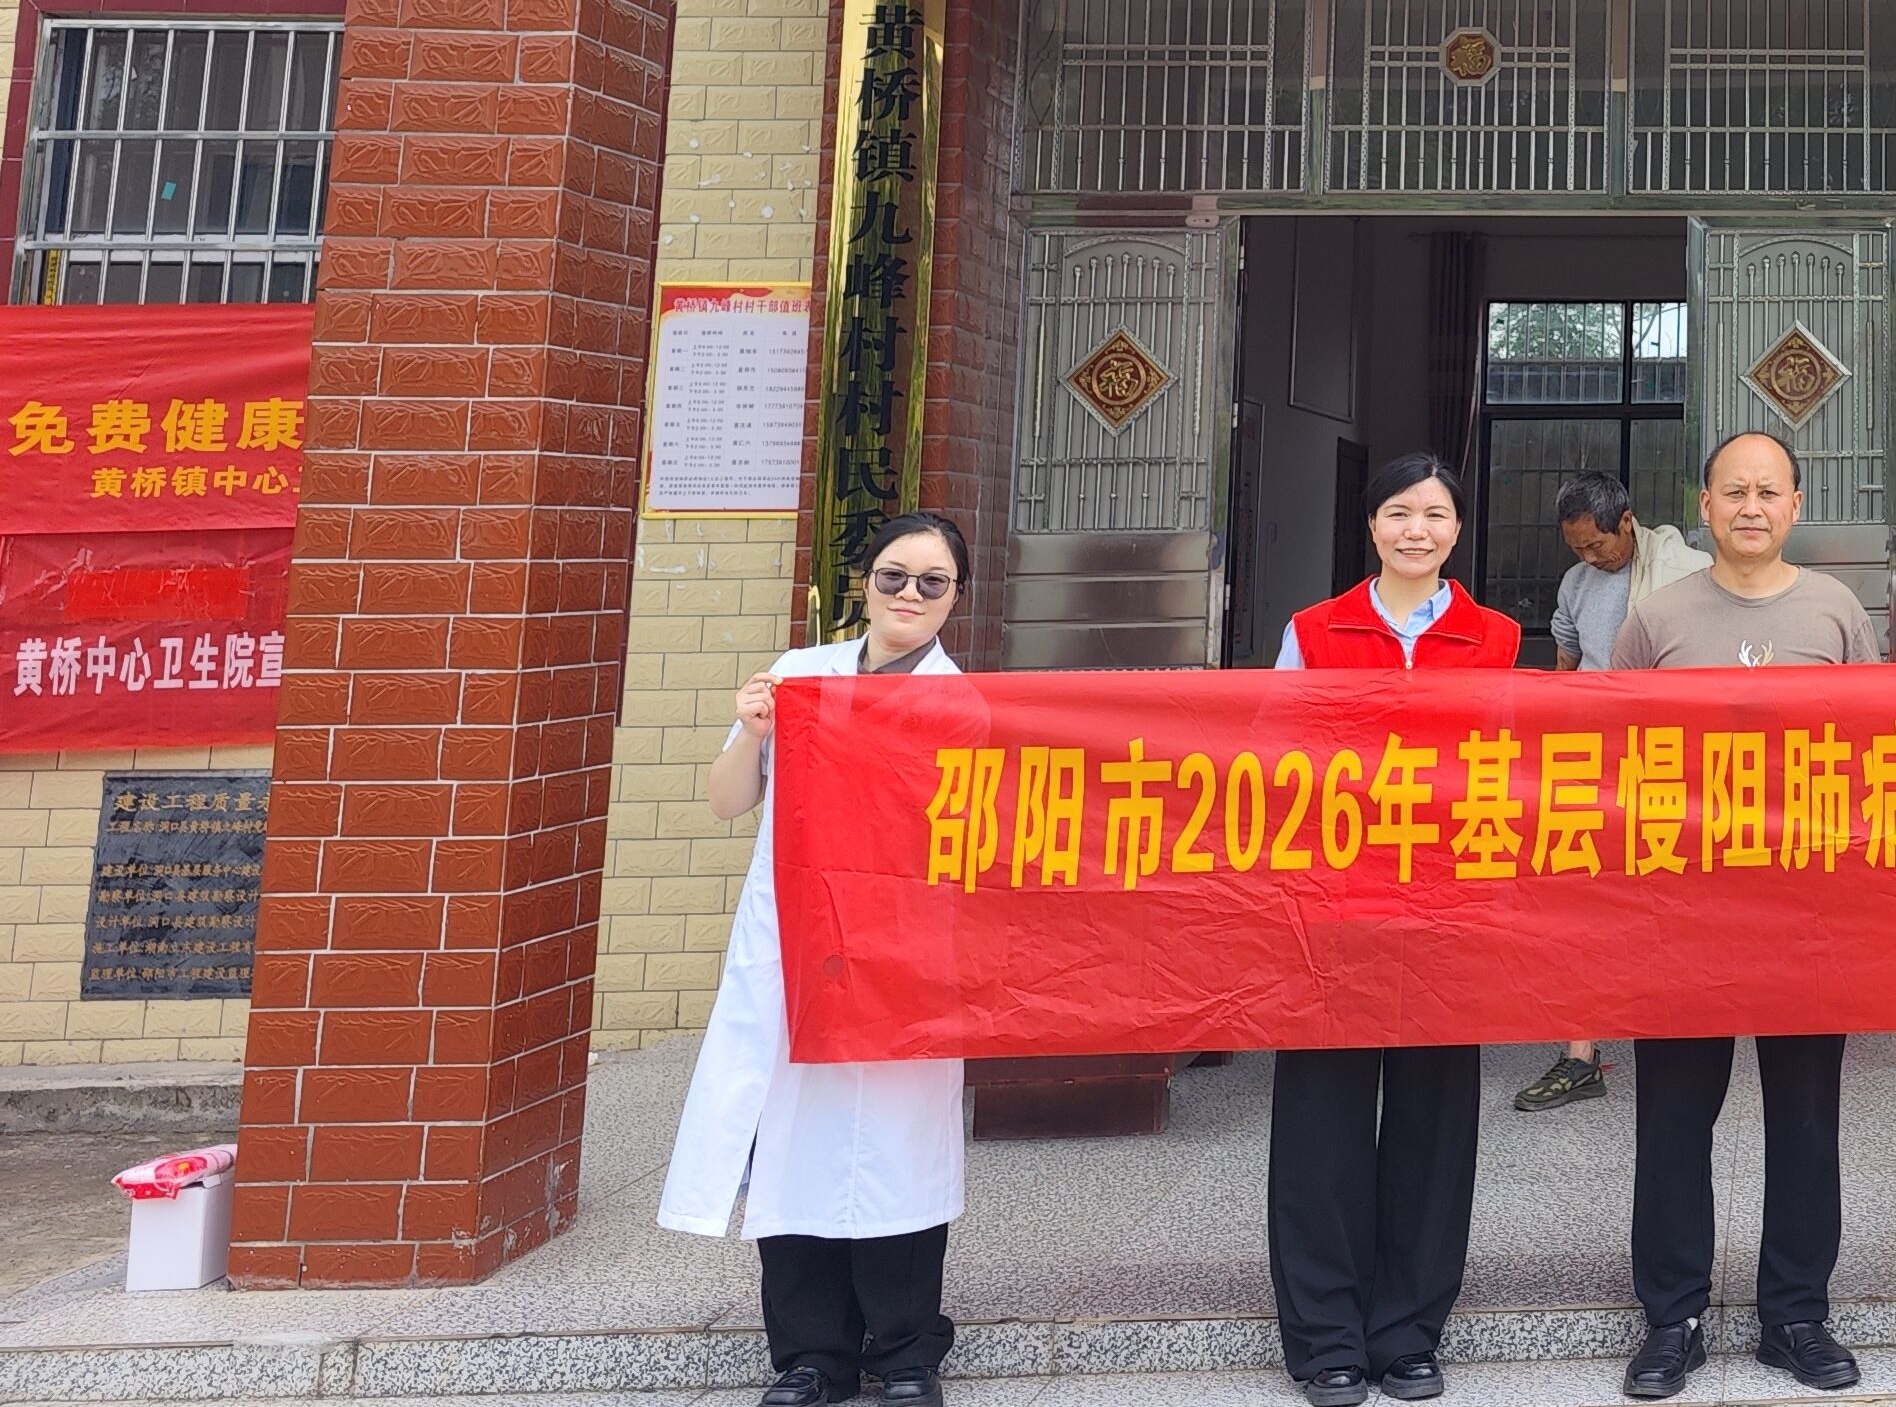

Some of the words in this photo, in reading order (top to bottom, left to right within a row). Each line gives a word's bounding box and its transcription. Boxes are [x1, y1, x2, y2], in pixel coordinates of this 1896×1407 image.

[7, 397, 304, 457] 免费健康
[90, 464, 302, 499] 黄桥镇中心
[13, 630, 286, 697] 黄桥中心卫生院宣
